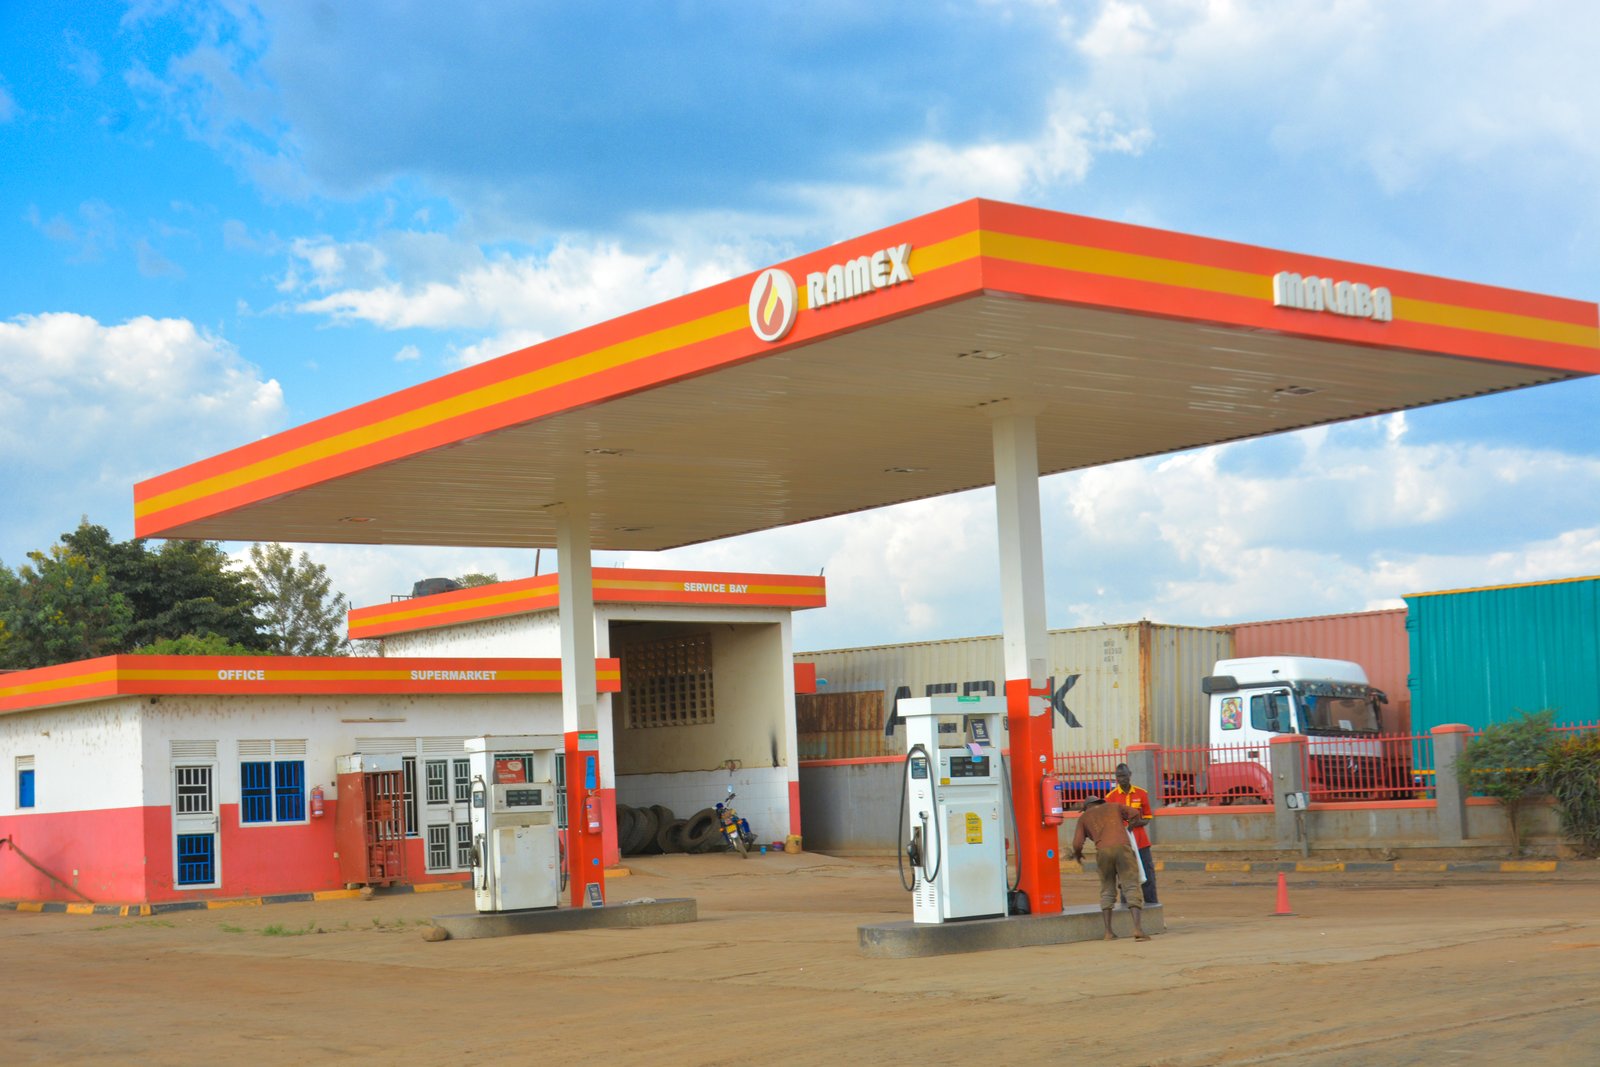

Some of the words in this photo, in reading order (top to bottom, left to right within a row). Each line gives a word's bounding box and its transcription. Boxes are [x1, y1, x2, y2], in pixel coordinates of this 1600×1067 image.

[806, 243, 913, 309] RAMEX
[1273, 271, 1393, 322] MALABA
[684, 582, 726, 593] SERVICE
[729, 584, 748, 594] BAY
[217, 670, 265, 681] OFFICE
[410, 670, 497, 681] SUPERMARKET
